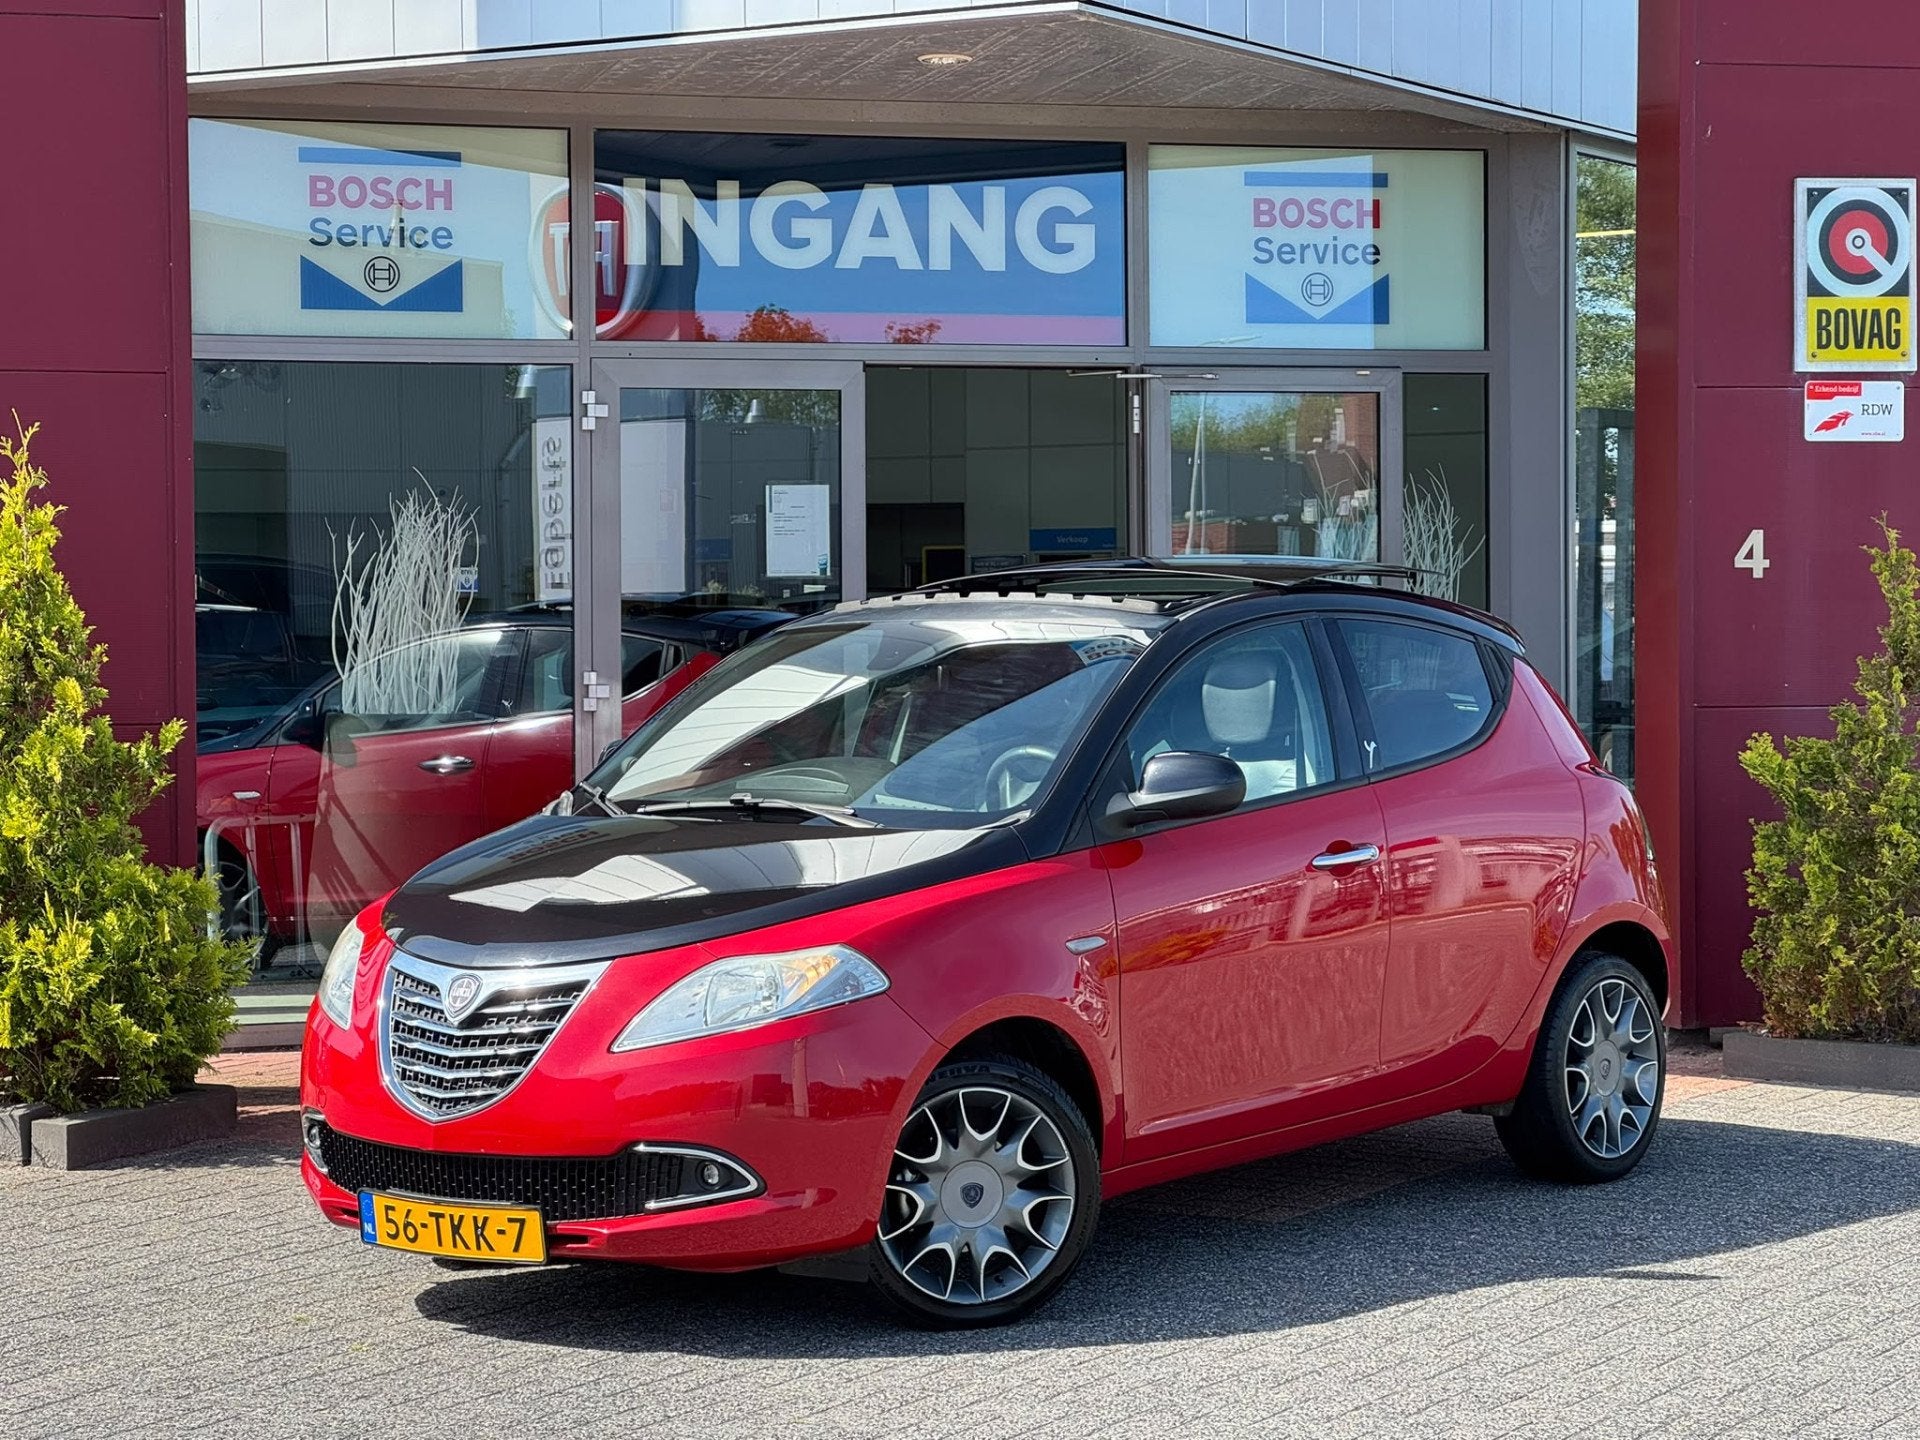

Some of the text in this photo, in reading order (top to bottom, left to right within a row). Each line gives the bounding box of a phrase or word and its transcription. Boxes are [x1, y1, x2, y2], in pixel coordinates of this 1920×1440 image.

[310, 176, 453, 211] BOSCH
[623, 178, 1096, 274] INGANG
[1253, 198, 1380, 229] BOSCH
[308, 218, 453, 249] Service
[1253, 236, 1380, 265] Service
[1816, 308, 1901, 350] BOVAG
[1861, 404, 1893, 416] RDW
[1734, 530, 1770, 579] 4
[364, 1205, 526, 1253] NL 56-TKK-7
